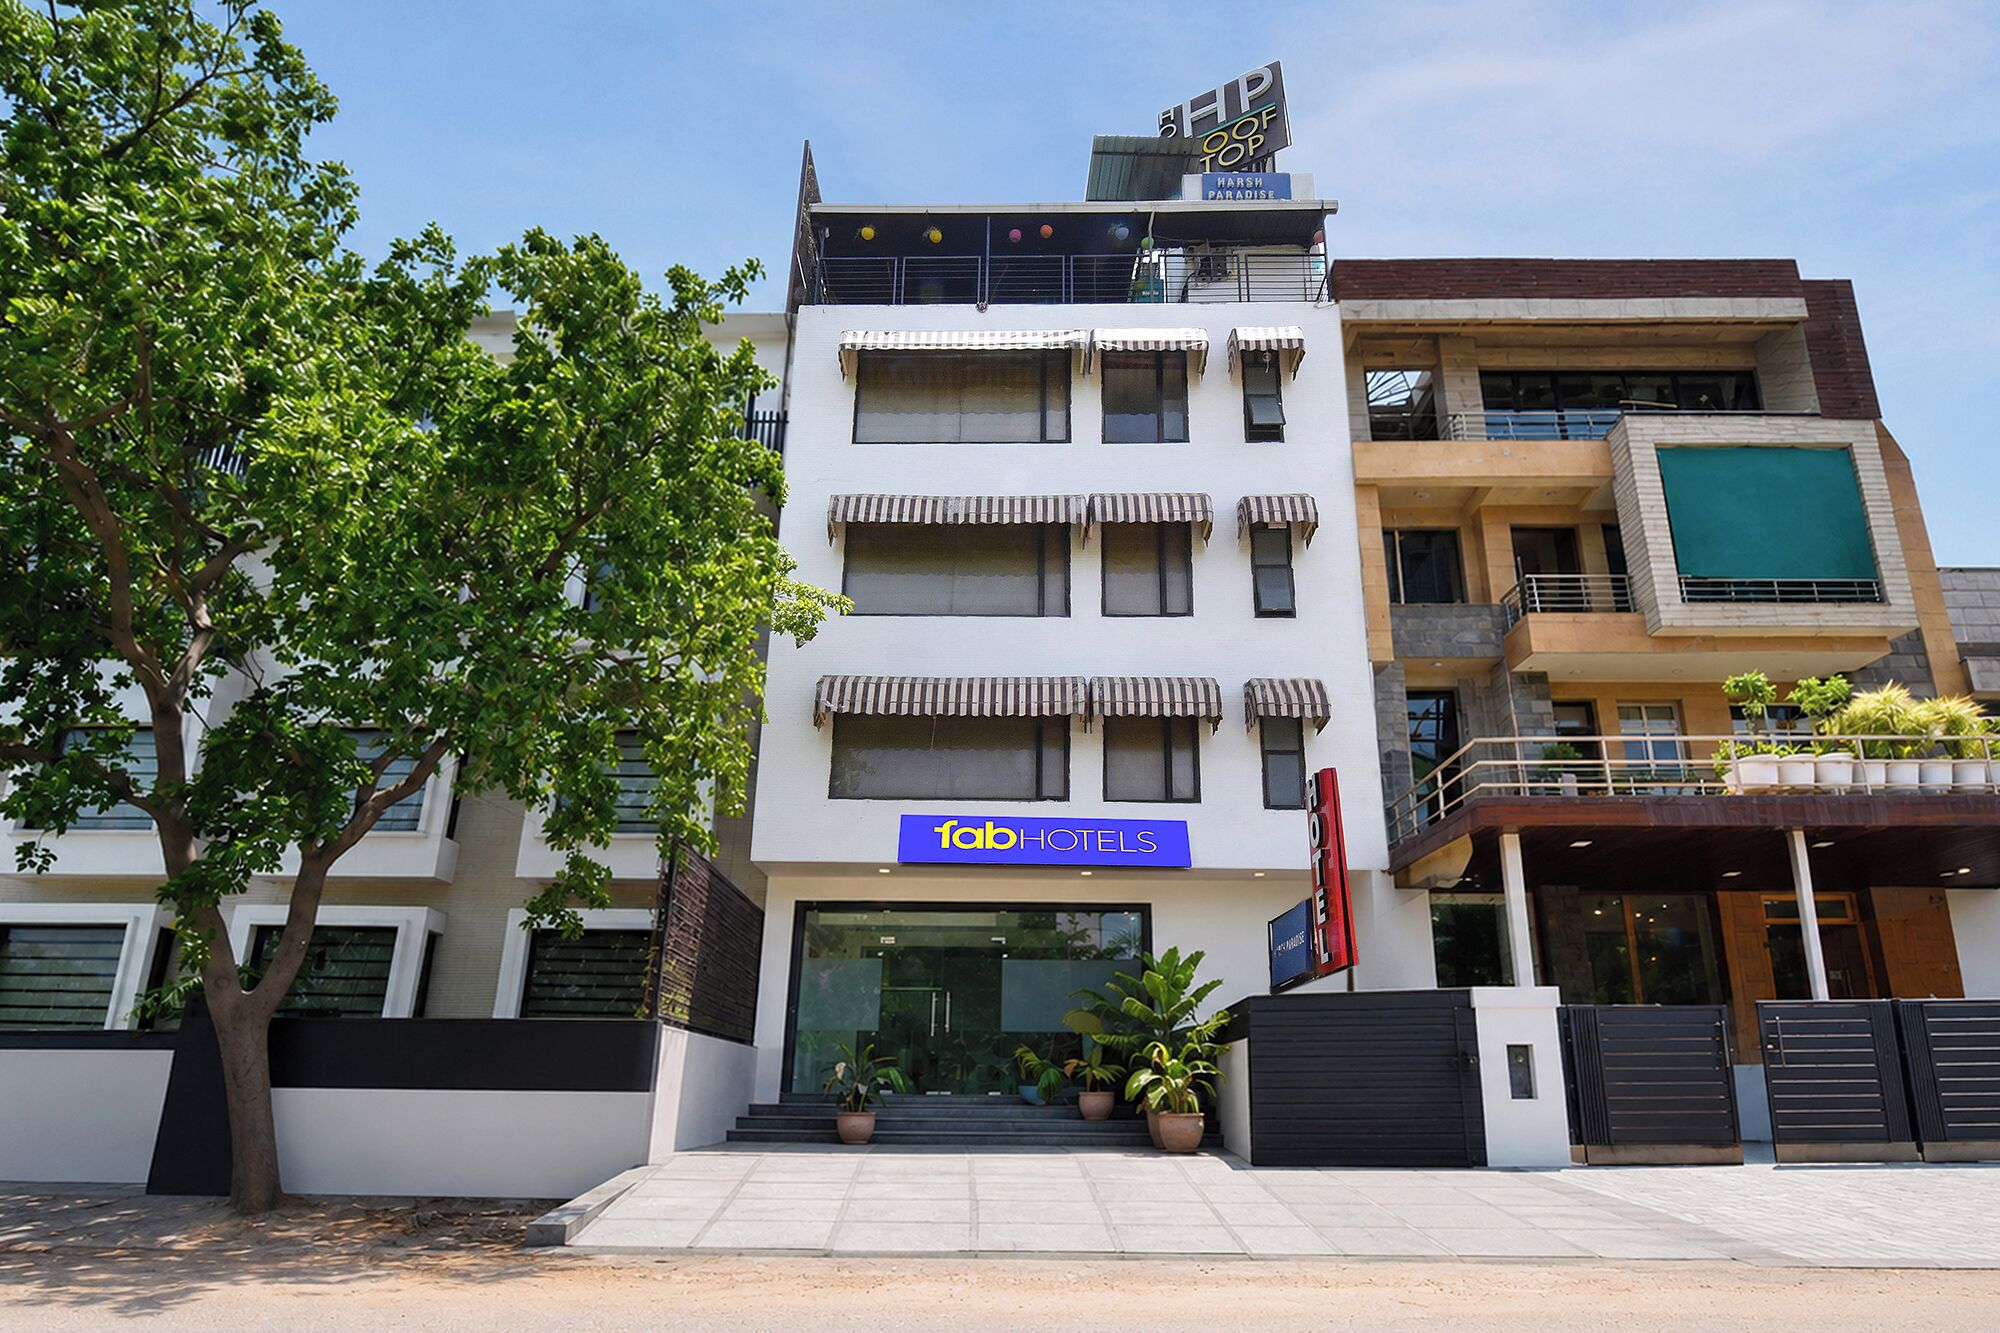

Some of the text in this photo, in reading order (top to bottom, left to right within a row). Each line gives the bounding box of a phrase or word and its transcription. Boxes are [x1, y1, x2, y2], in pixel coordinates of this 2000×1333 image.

[1182, 67, 1274, 138] HP
[1201, 106, 1277, 154] OOF
[1200, 135, 1265, 173] TOP
[1208, 191, 1275, 201] PARADISE
[1217, 177, 1263, 188] HARSH
[934, 820, 1158, 853] fabHOTELS
[1306, 773, 1332, 964] HOTEL
